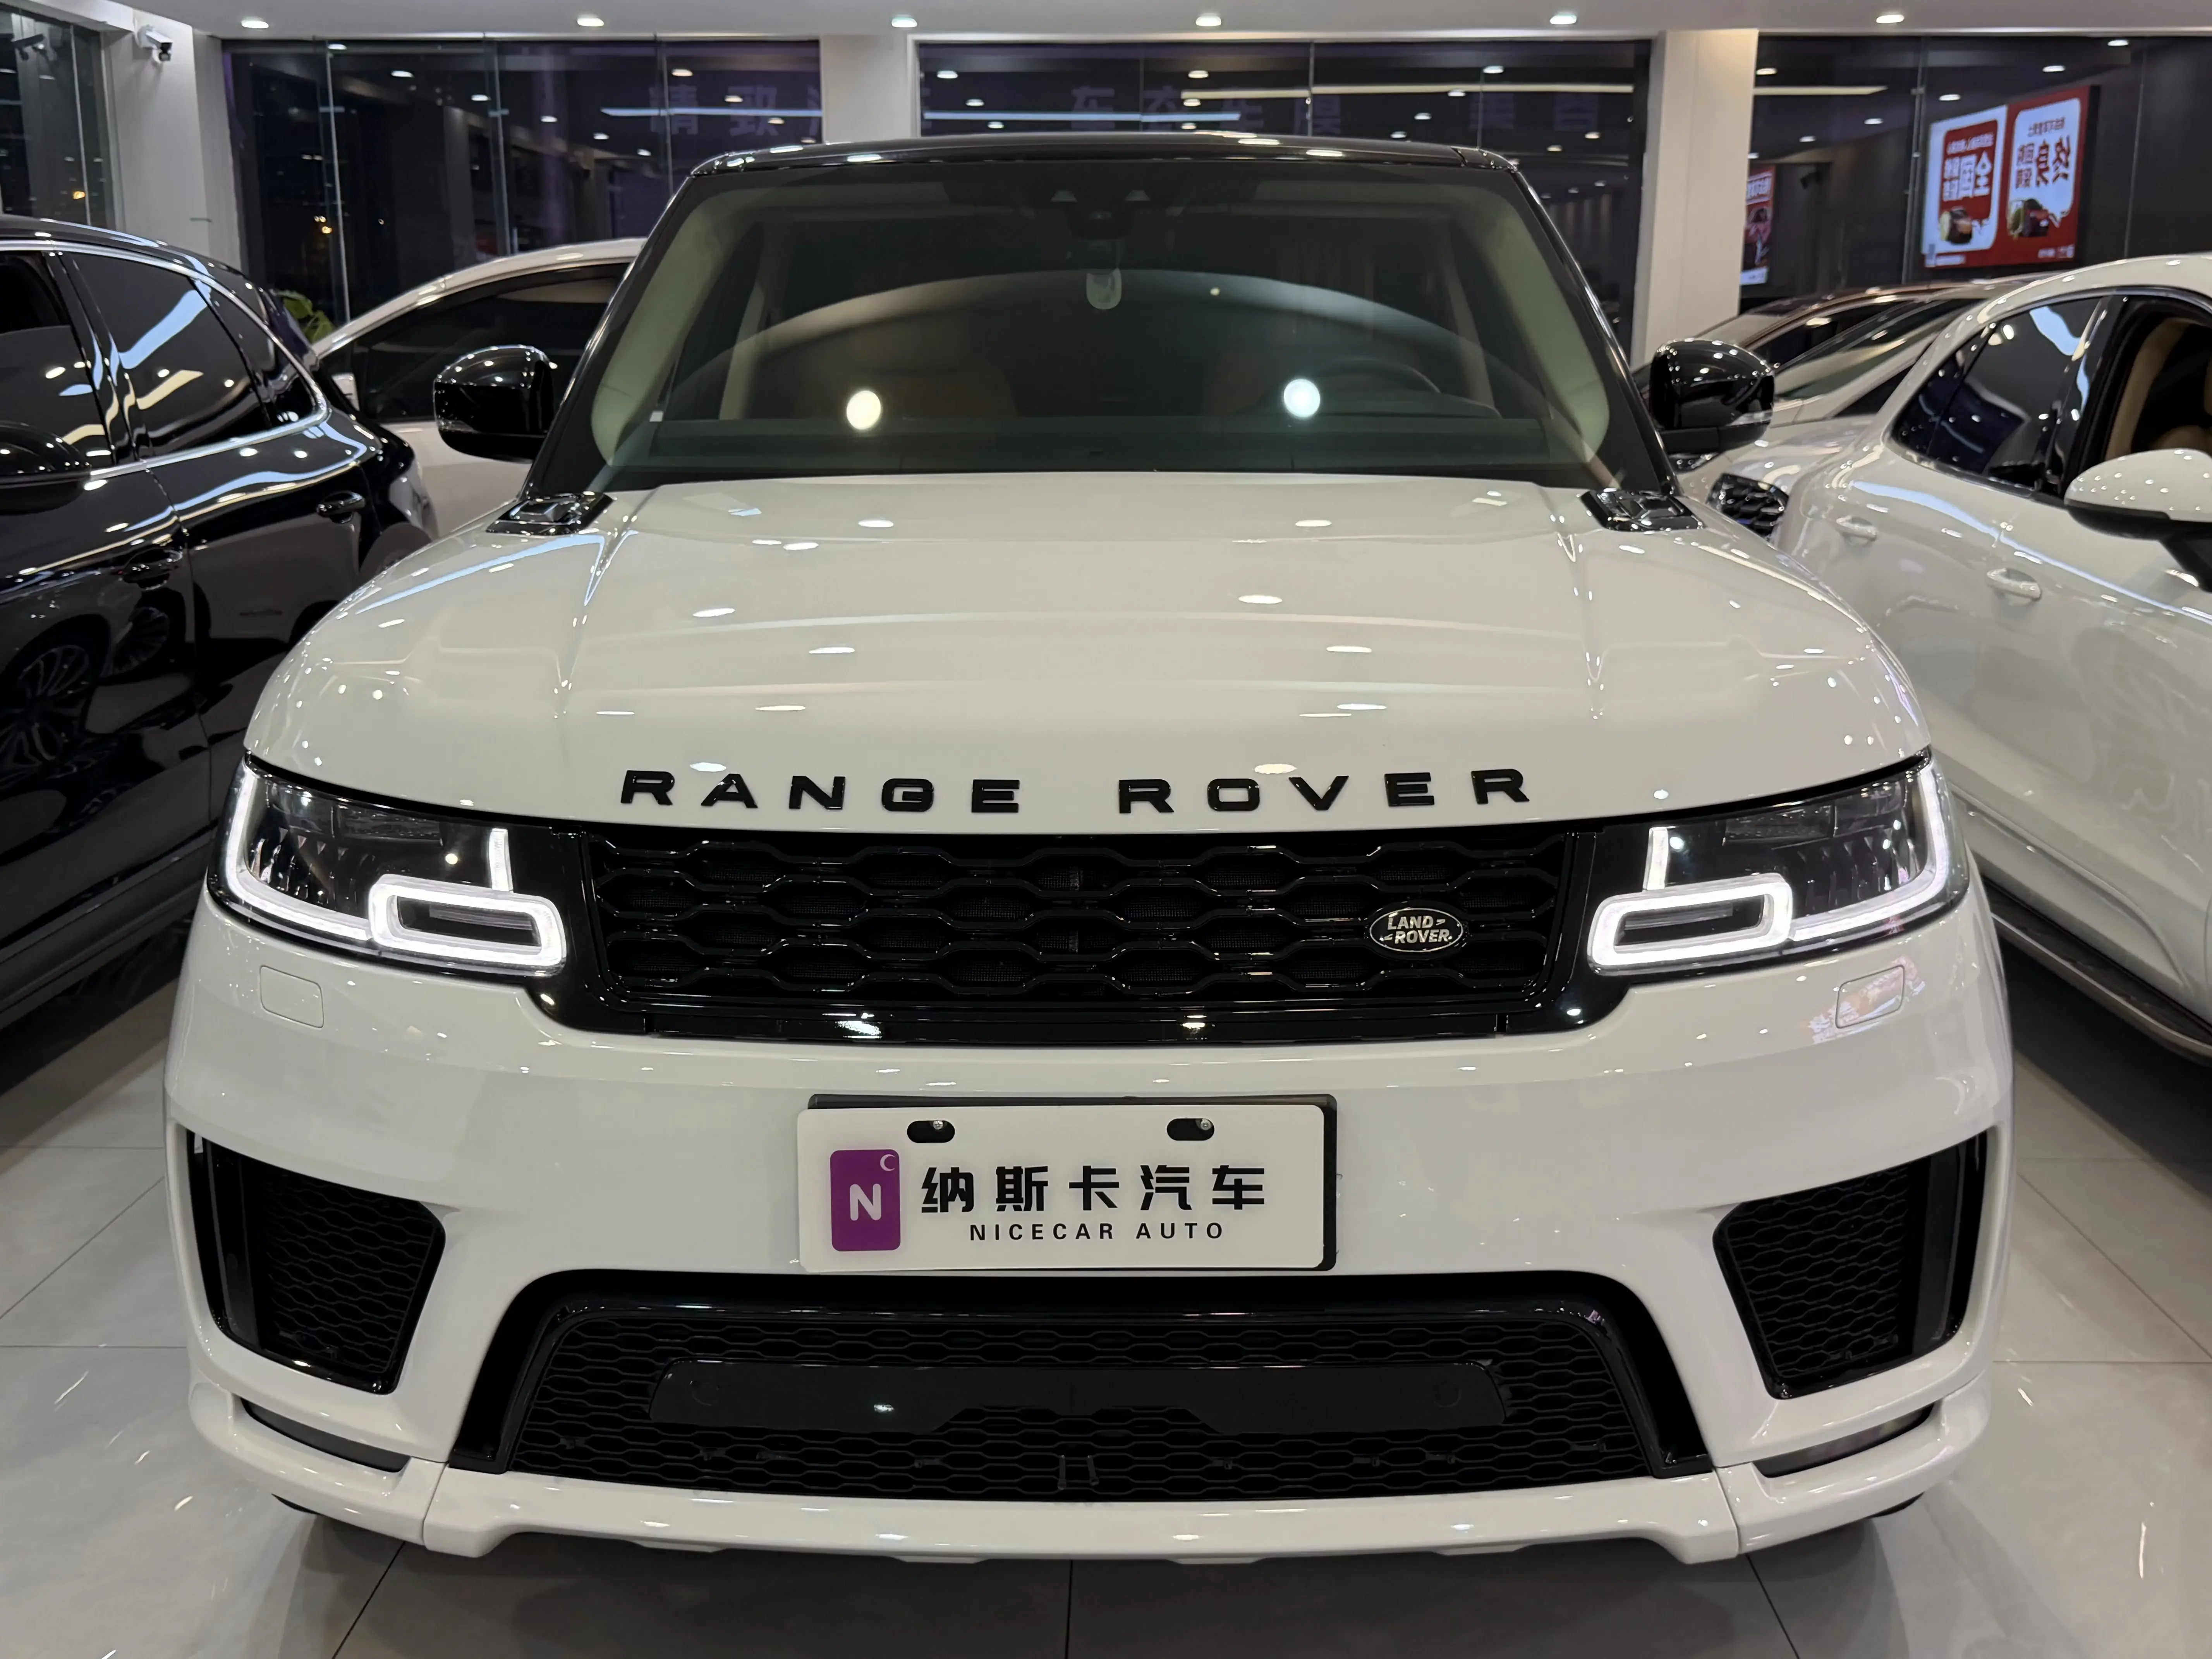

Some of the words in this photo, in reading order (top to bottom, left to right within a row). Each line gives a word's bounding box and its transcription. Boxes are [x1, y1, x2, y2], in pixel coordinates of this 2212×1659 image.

[620, 770, 1020, 813] RANGE
[1118, 769, 1530, 814] ROVER
[1395, 929, 1450, 944] ROVER
[849, 1183, 882, 1221] N
[921, 1164, 1265, 1213] 纳斯卡汽车
[970, 1223, 1113, 1241] NICECAR
[1135, 1222, 1223, 1239] AUTO
